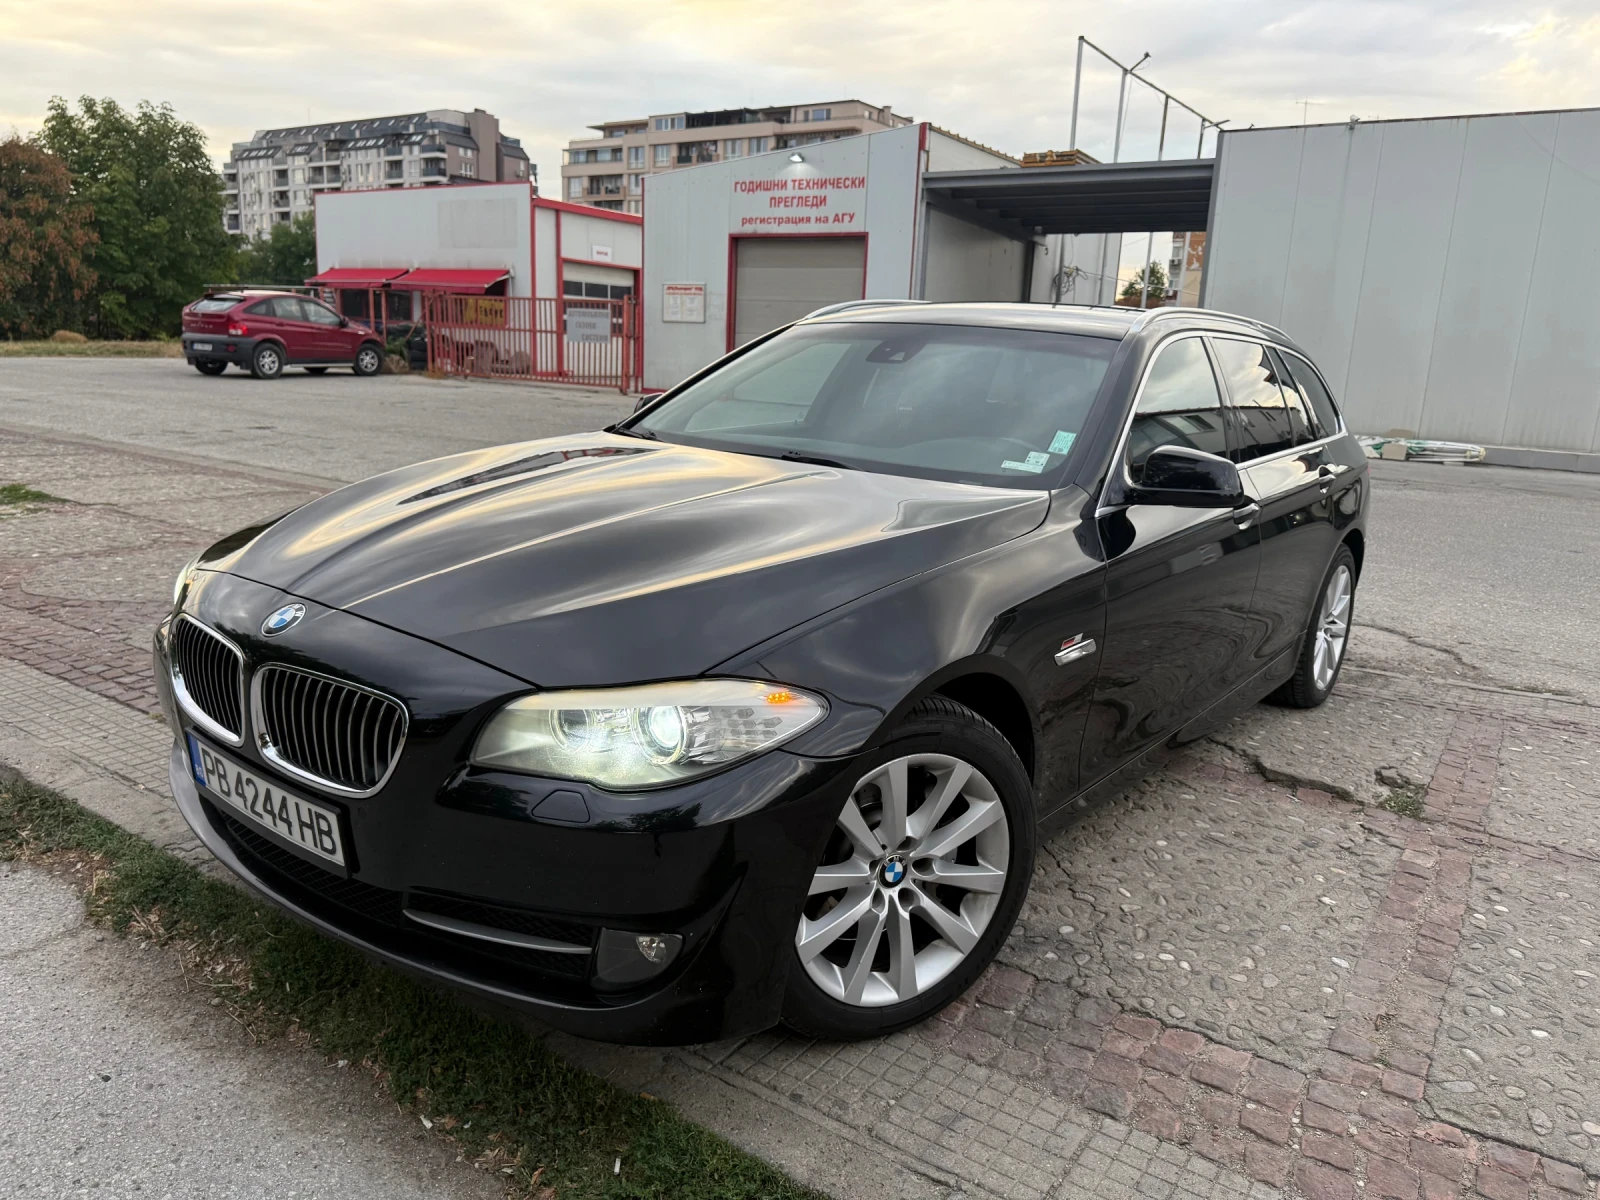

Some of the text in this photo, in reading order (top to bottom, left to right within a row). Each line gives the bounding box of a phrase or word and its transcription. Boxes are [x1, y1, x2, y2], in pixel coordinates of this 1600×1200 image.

[734, 176, 866, 194] ГОДИШНИ ТЕХНИЧЕСКИ
[769, 195, 827, 209] ПРЕГЛЕДИ
[741, 212, 856, 227] регистрация на АГУ
[201, 747, 337, 855] PB 4244 HB
